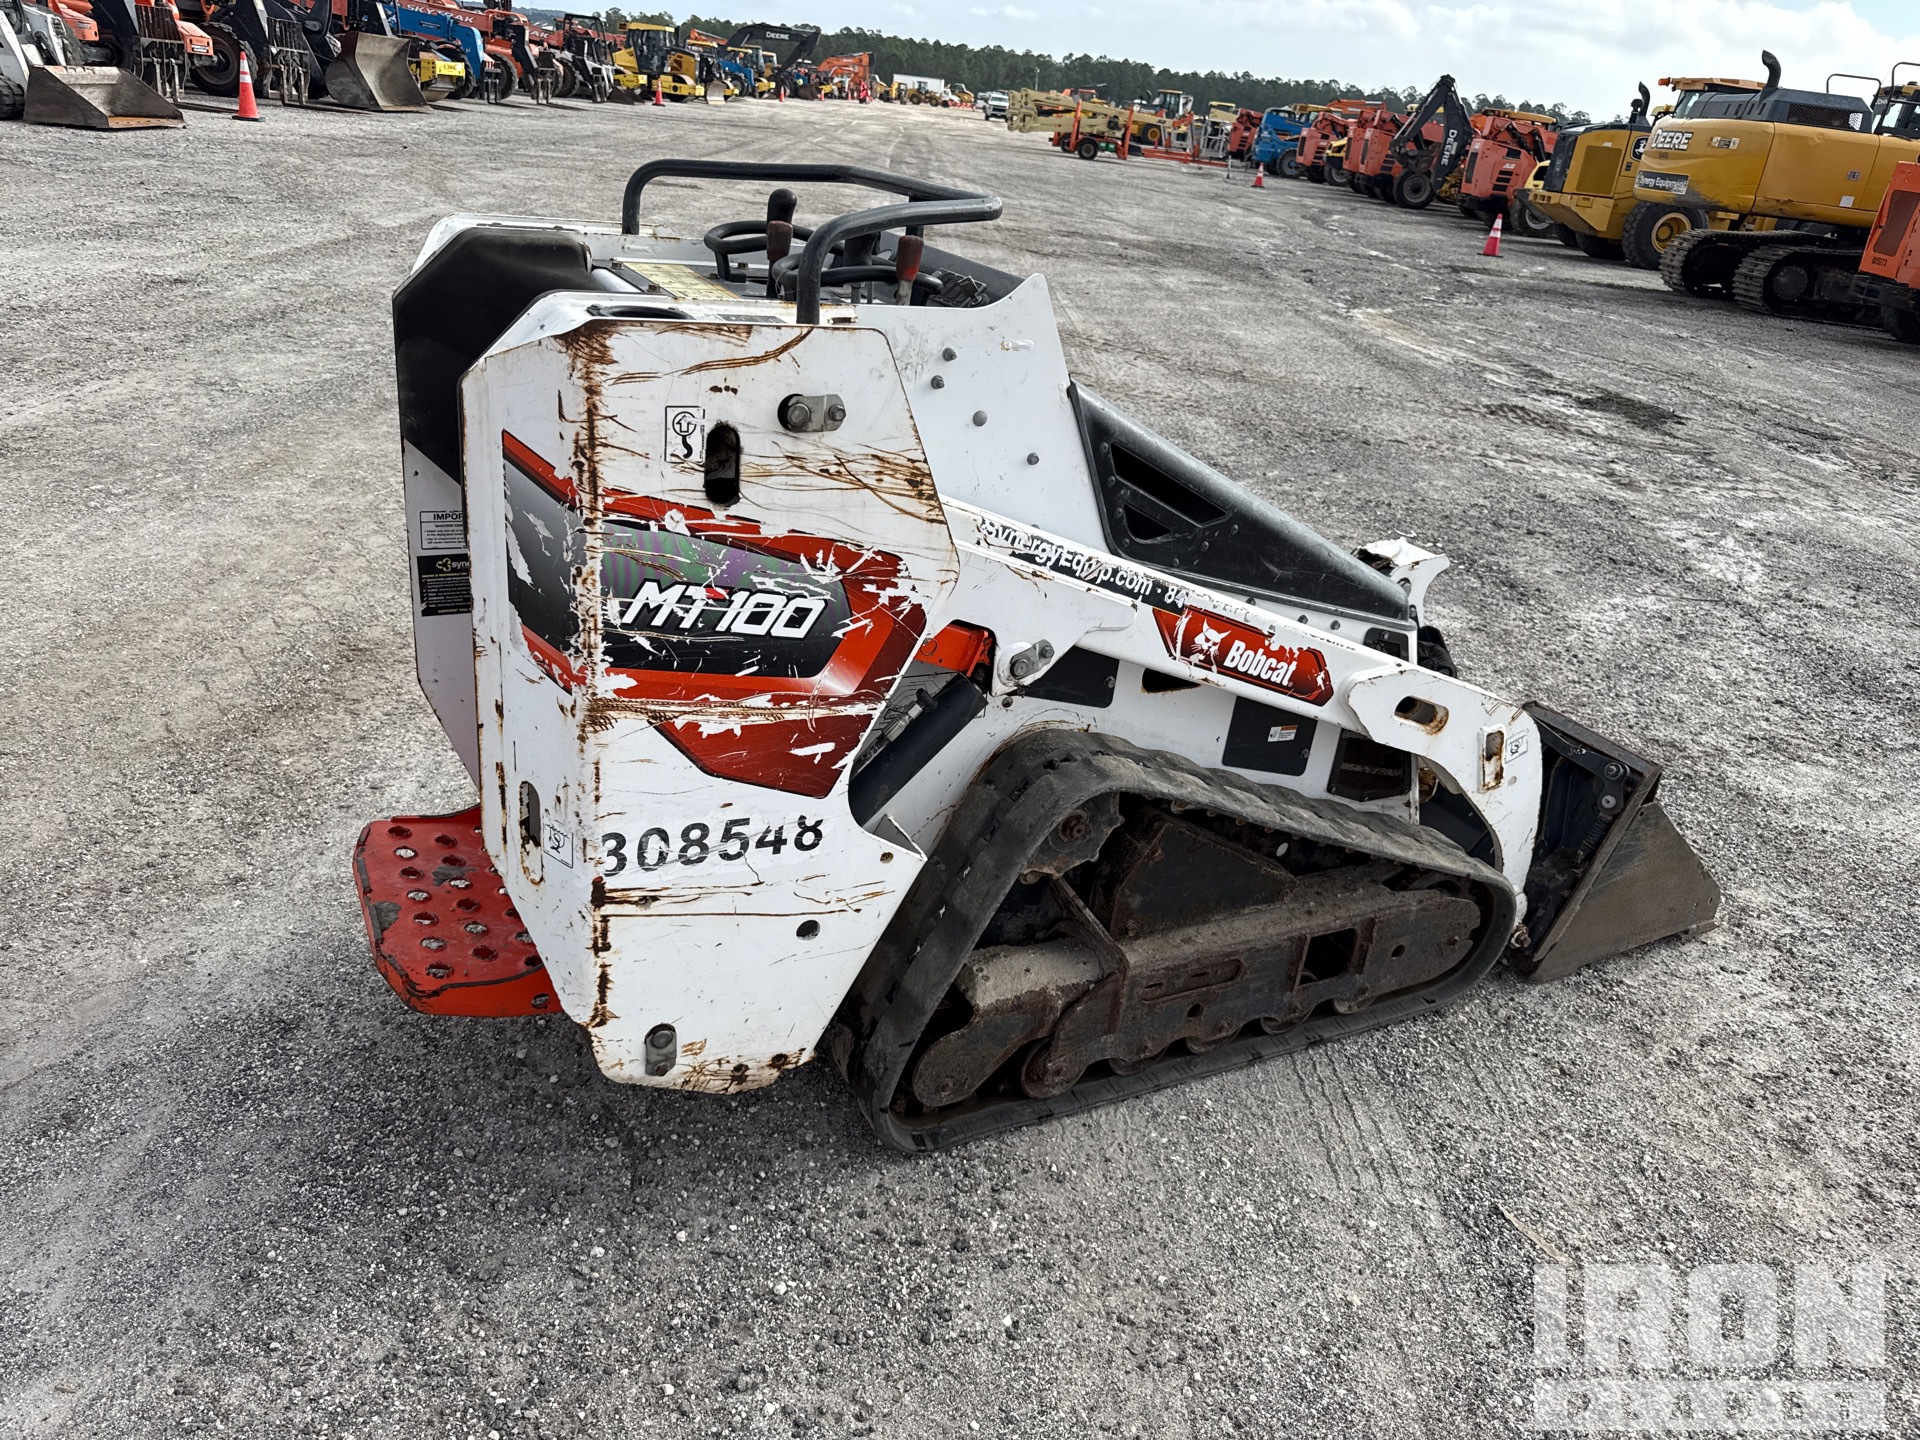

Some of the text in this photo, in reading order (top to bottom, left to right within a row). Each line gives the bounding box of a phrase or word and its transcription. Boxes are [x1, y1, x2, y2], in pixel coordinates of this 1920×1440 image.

[765, 31, 790, 40] DEERE
[1441, 129, 1458, 166] DEERE
[1650, 128, 1695, 151] DEERE
[1222, 639, 1297, 688] Bobcat
[600, 815, 824, 877] 308548
